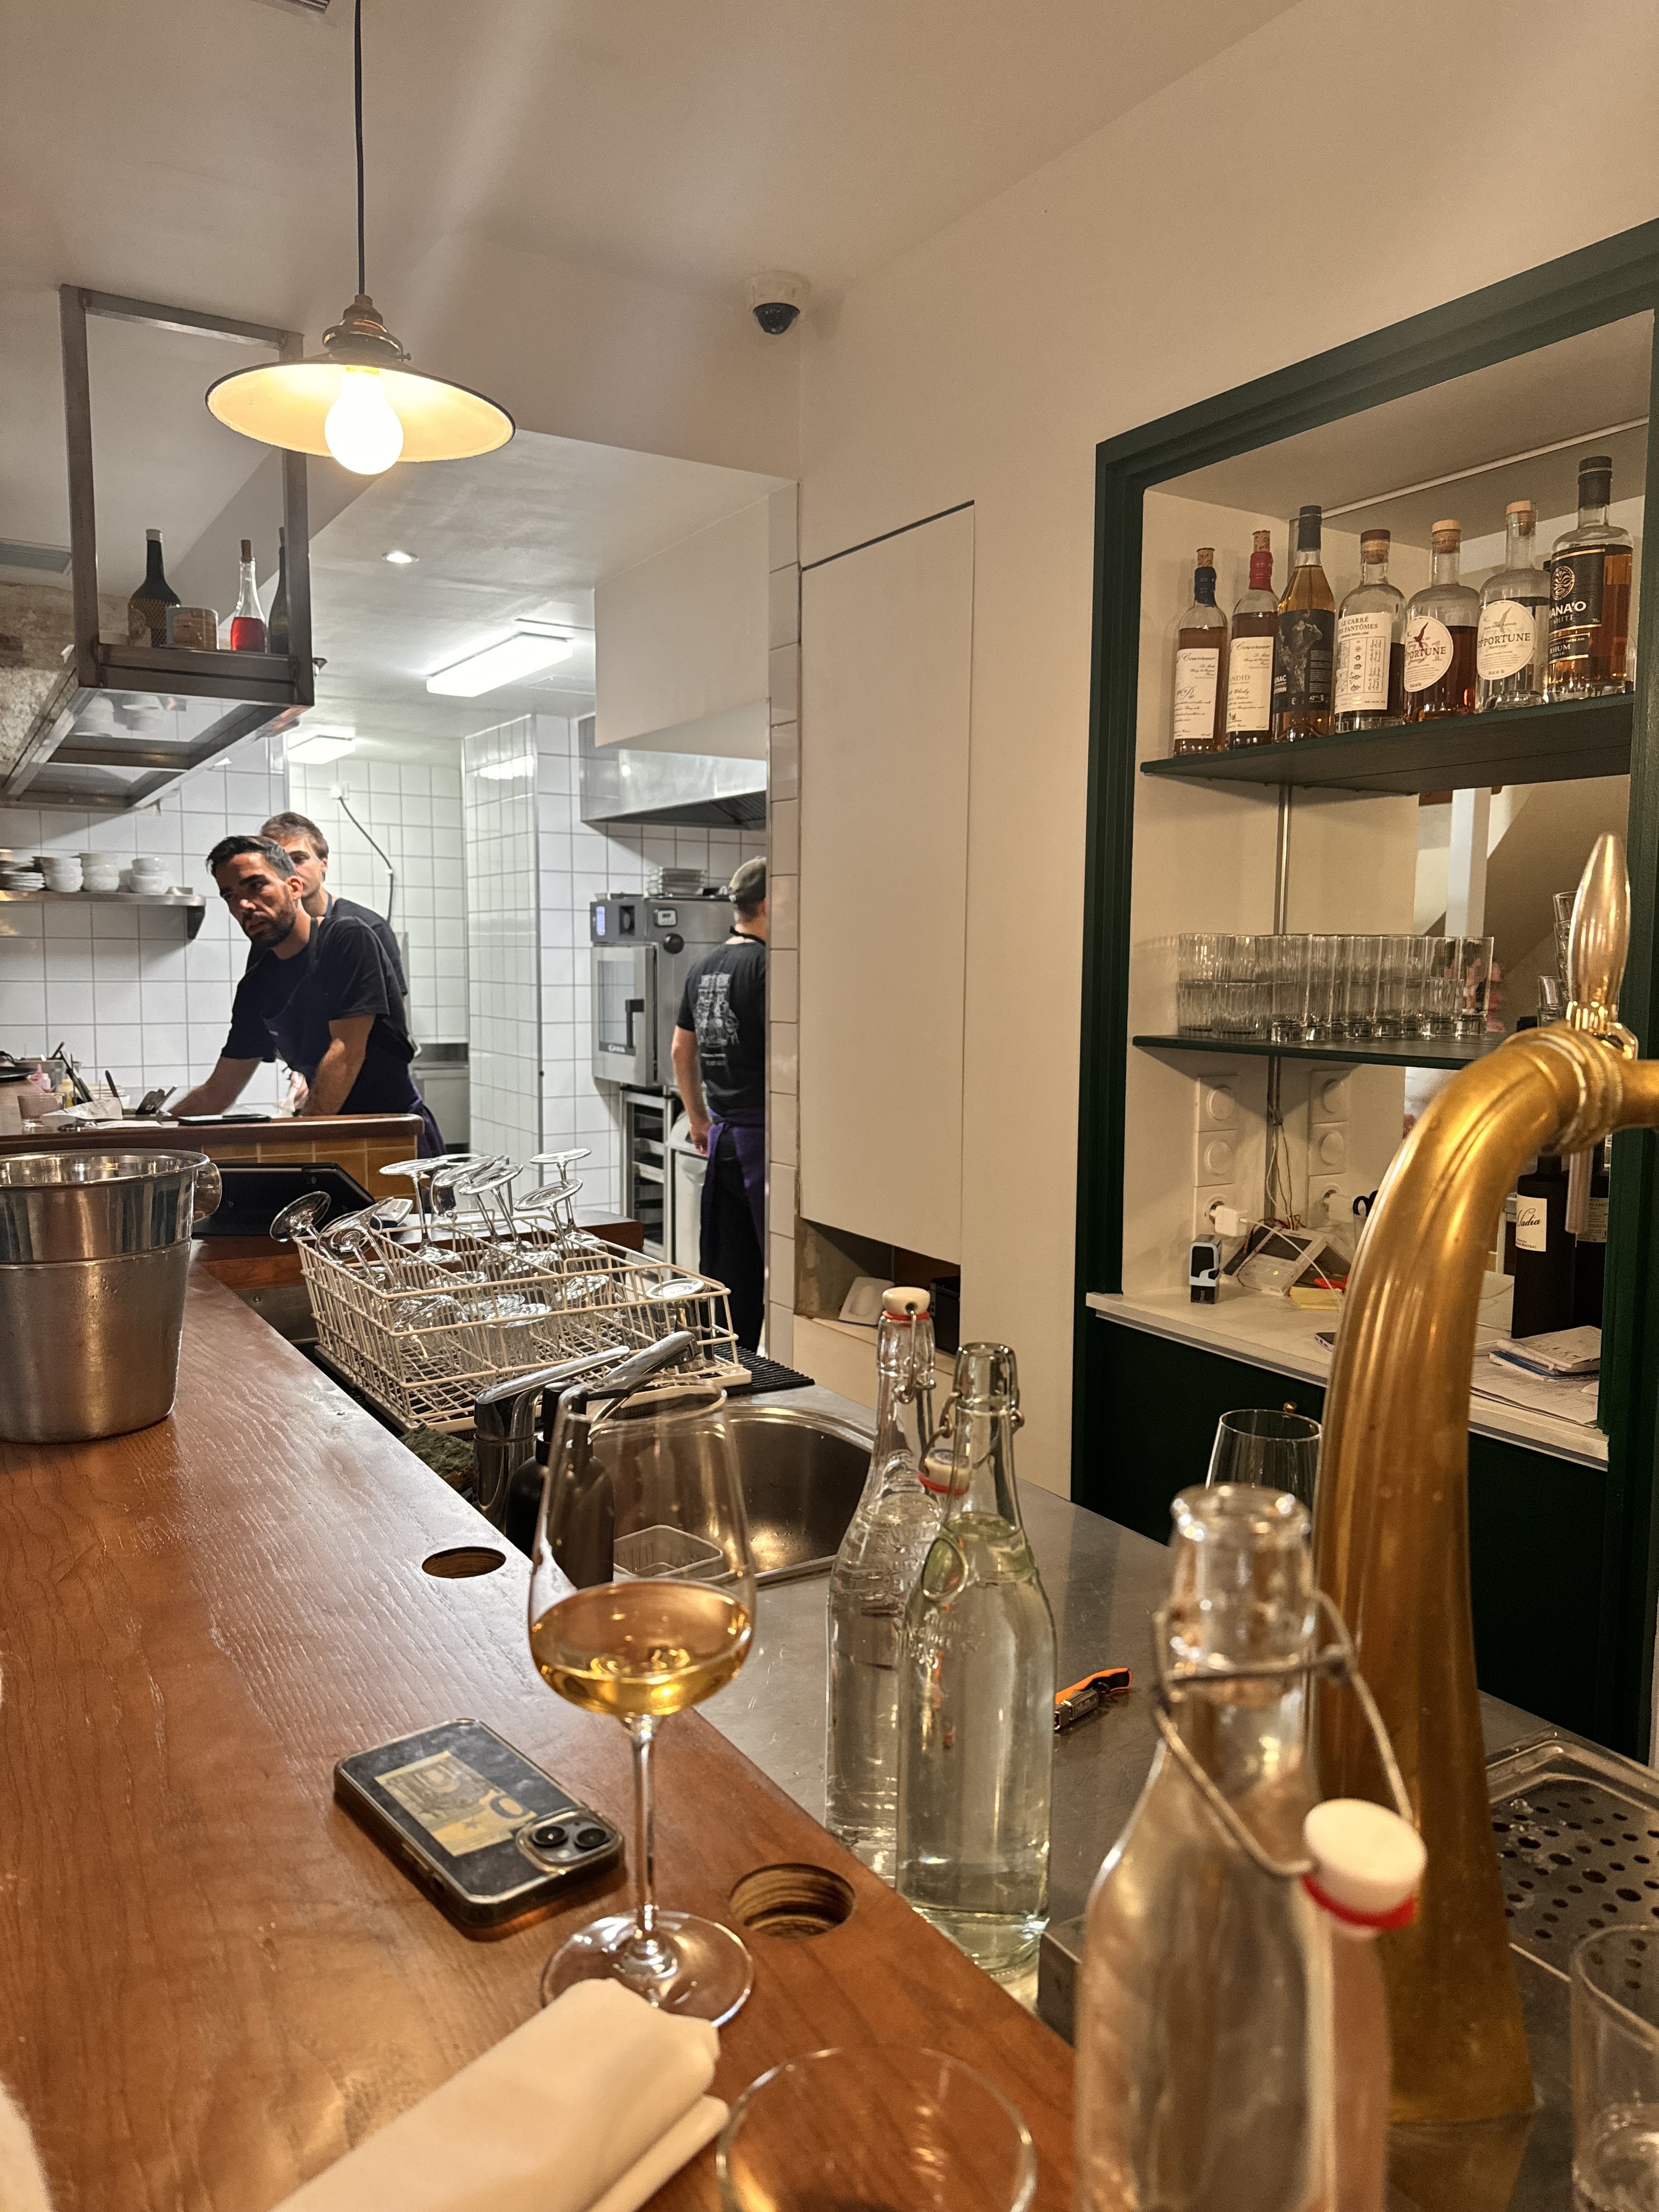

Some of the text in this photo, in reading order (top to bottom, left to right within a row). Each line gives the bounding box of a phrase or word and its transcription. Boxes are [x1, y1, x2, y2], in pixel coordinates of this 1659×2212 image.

[1347, 616, 1369, 625] CARRÉ
[1344, 623, 1378, 633] FANTÔMES
[1550, 644, 1571, 654] RHUM
